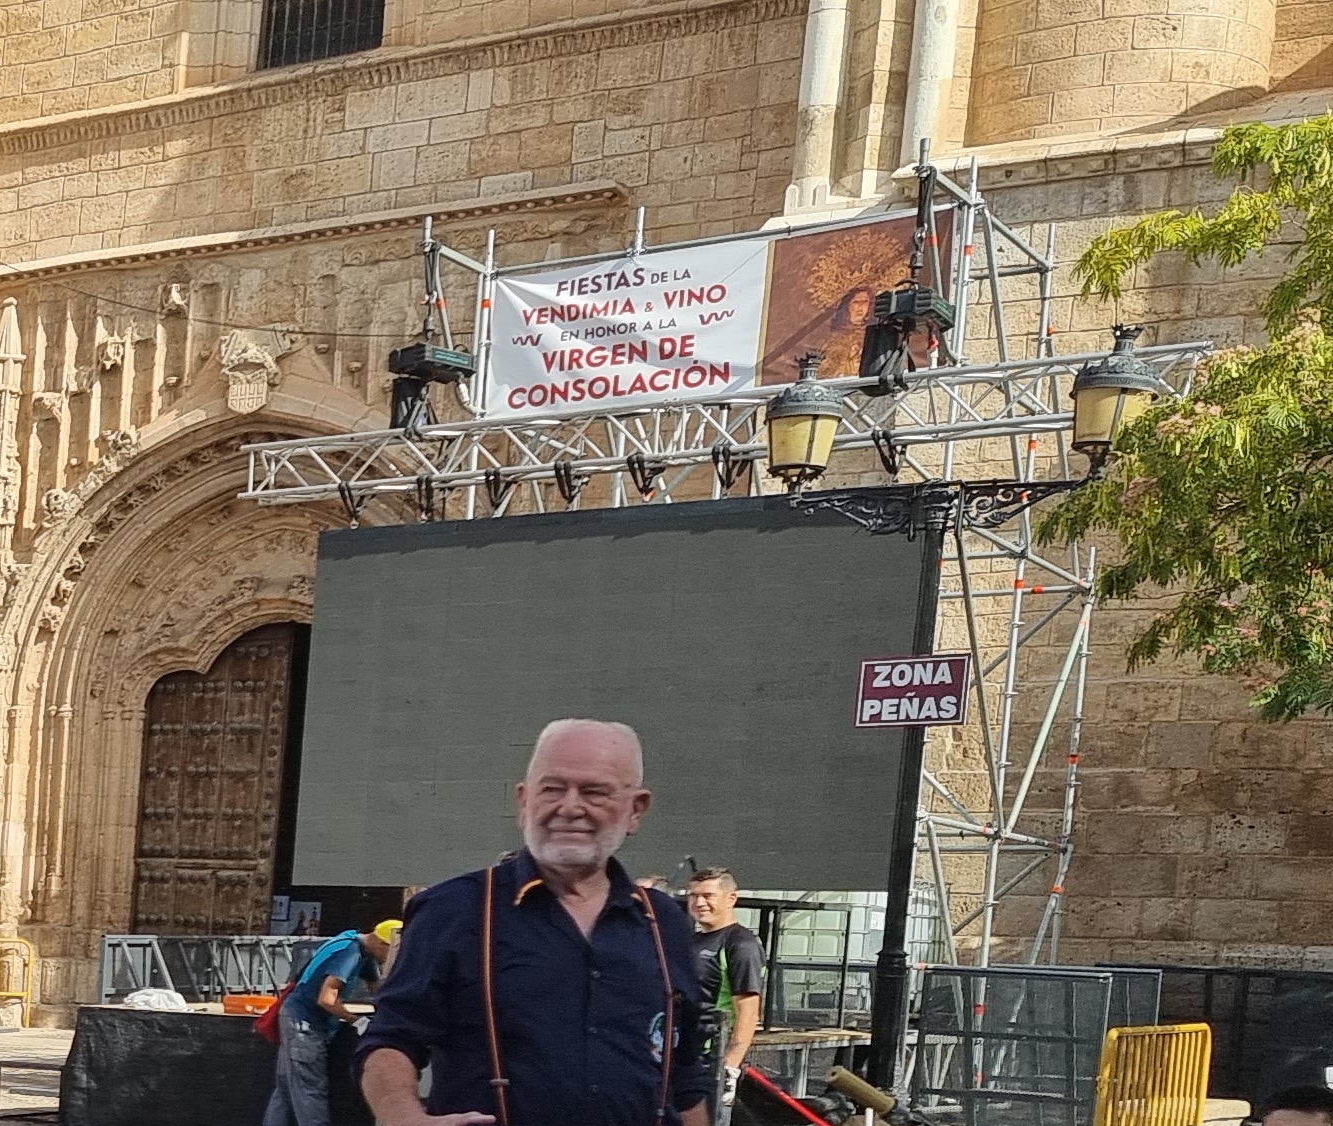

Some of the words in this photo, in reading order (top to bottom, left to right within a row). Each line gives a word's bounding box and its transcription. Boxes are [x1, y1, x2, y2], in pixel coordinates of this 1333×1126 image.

[555, 267, 646, 297] FIESTAS
[650, 271, 670, 285] DE
[673, 267, 692, 282] LA
[521, 297, 636, 327] VENDIMIA
[643, 301, 655, 314] &
[664, 283, 727, 310] VINO
[560, 328, 581, 342] EN
[584, 322, 638, 341] HONOR
[642, 320, 654, 332] A
[658, 316, 677, 331] LA
[542, 341, 650, 374] VIRGEN
[659, 334, 696, 360] DE
[507, 358, 730, 411] CONSOLACIÓN
[872, 663, 952, 688] ZONA
[862, 690, 957, 721] PEÑAS
